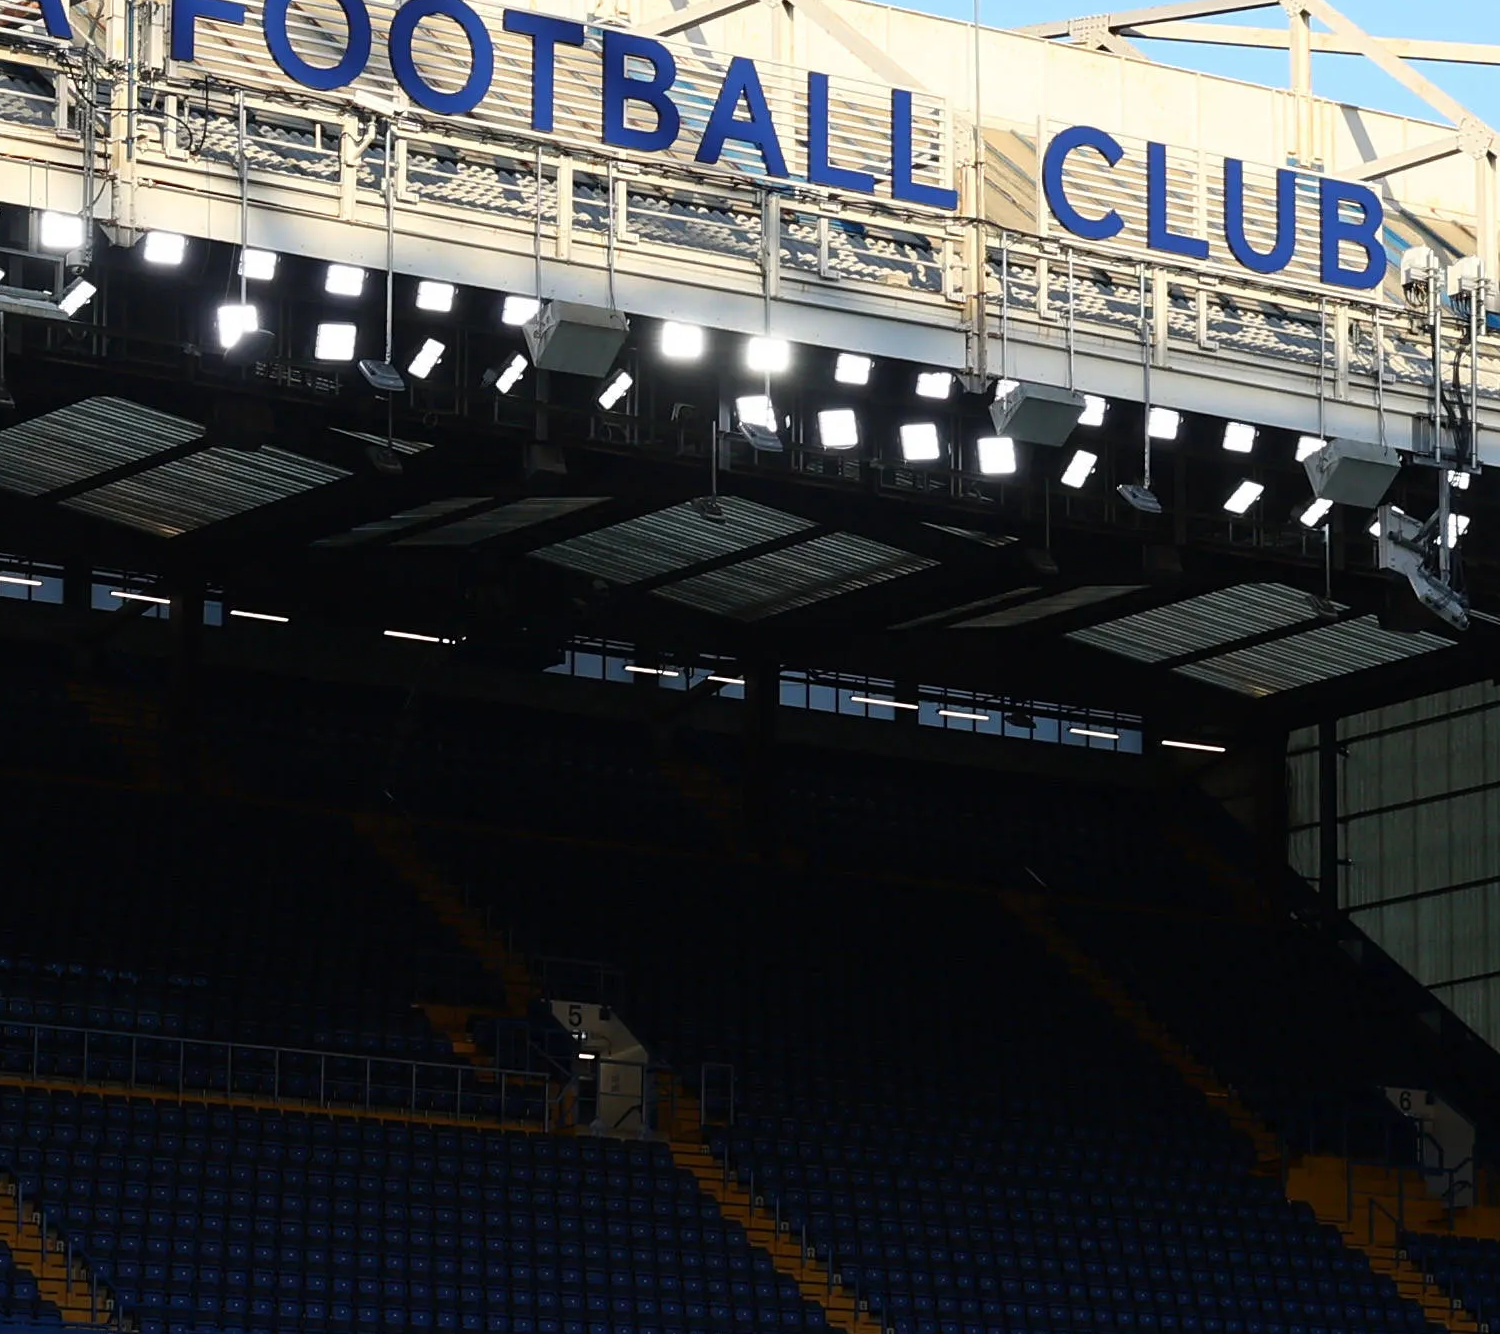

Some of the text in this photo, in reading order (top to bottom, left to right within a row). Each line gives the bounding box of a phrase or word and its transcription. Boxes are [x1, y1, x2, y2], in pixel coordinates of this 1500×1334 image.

[1041, 125, 1387, 290] CLUB
[568, 1005, 582, 1027] 5
[1400, 1091, 1411, 1111] 6
